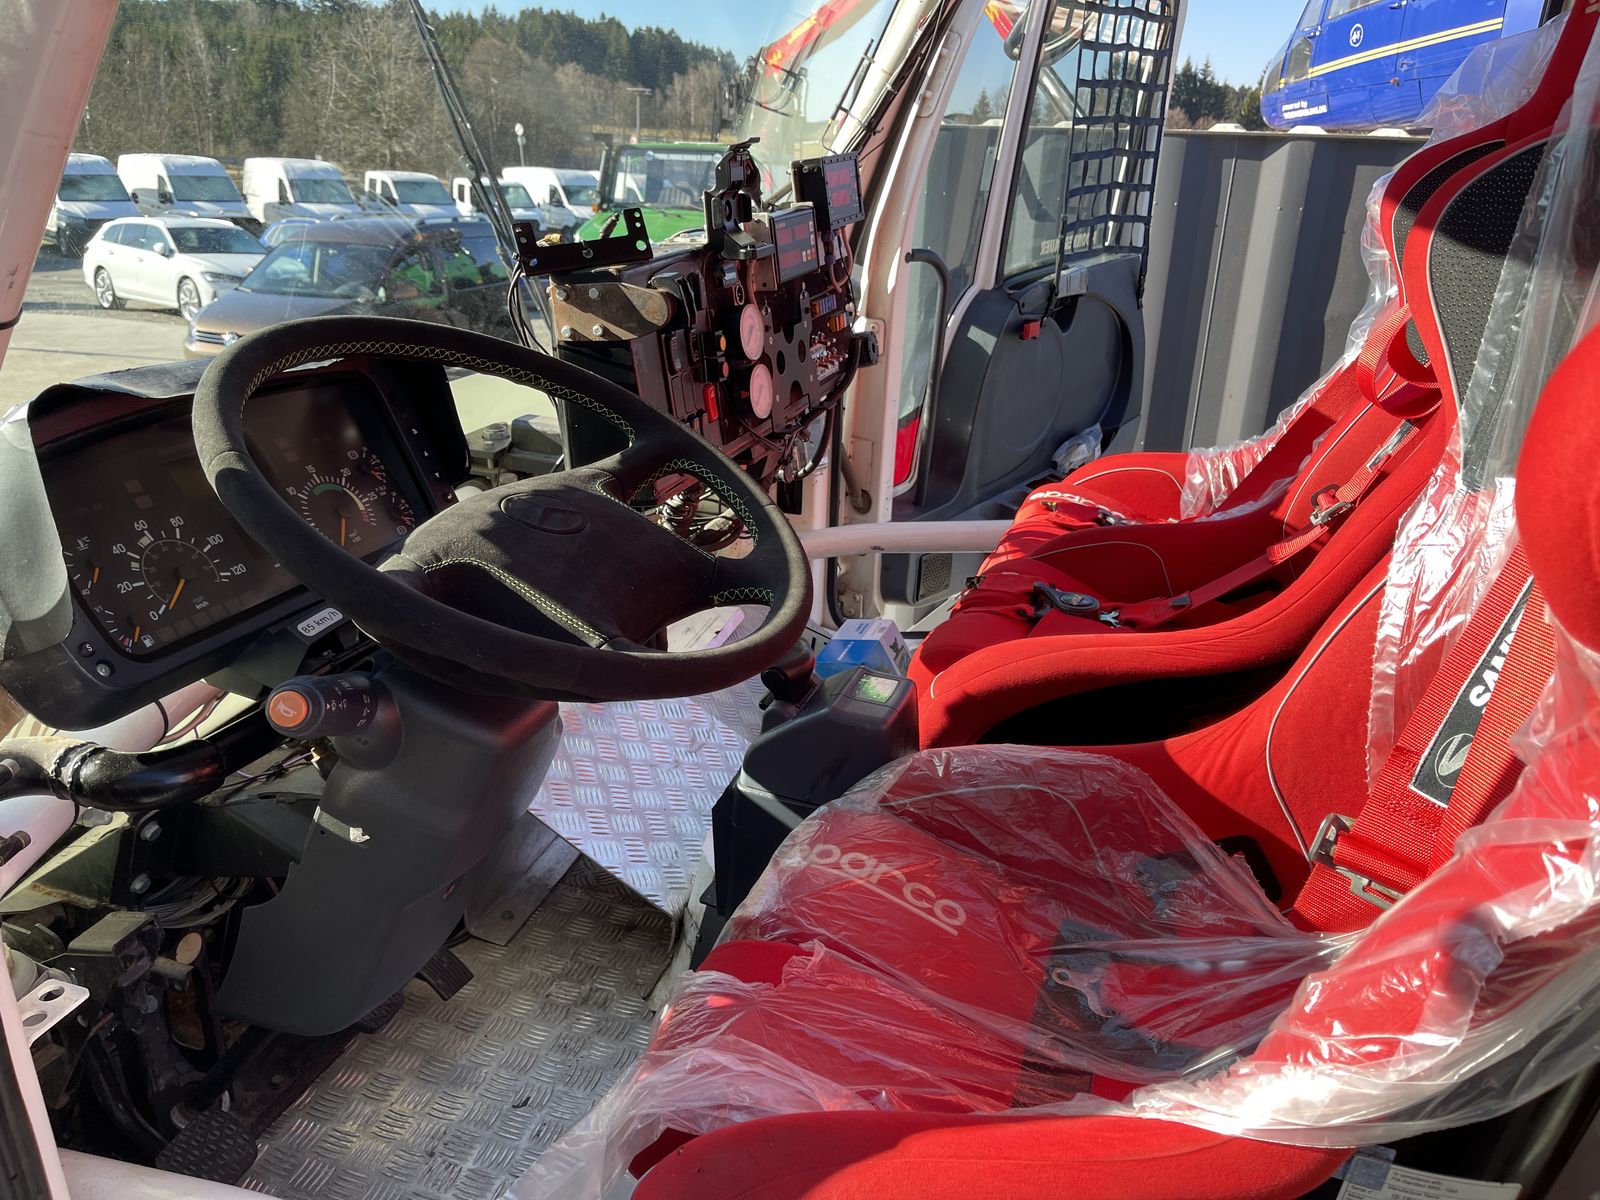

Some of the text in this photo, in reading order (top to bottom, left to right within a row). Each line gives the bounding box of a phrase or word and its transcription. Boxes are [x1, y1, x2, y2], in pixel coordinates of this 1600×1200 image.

[305, 464, 316, 473] 15
[340, 467, 352, 477] 20
[286, 486, 297, 496] 10
[134, 519, 148, 531] 60
[169, 515, 184, 527] 80
[206, 533, 224, 547] 100
[112, 542, 127, 555] 40
[230, 563, 247, 577] 120
[117, 581, 133, 594] 20
[149, 610, 159, 621] 0
[301, 611, 340, 634] 85 km/h
[86, 643, 93, 652] S
